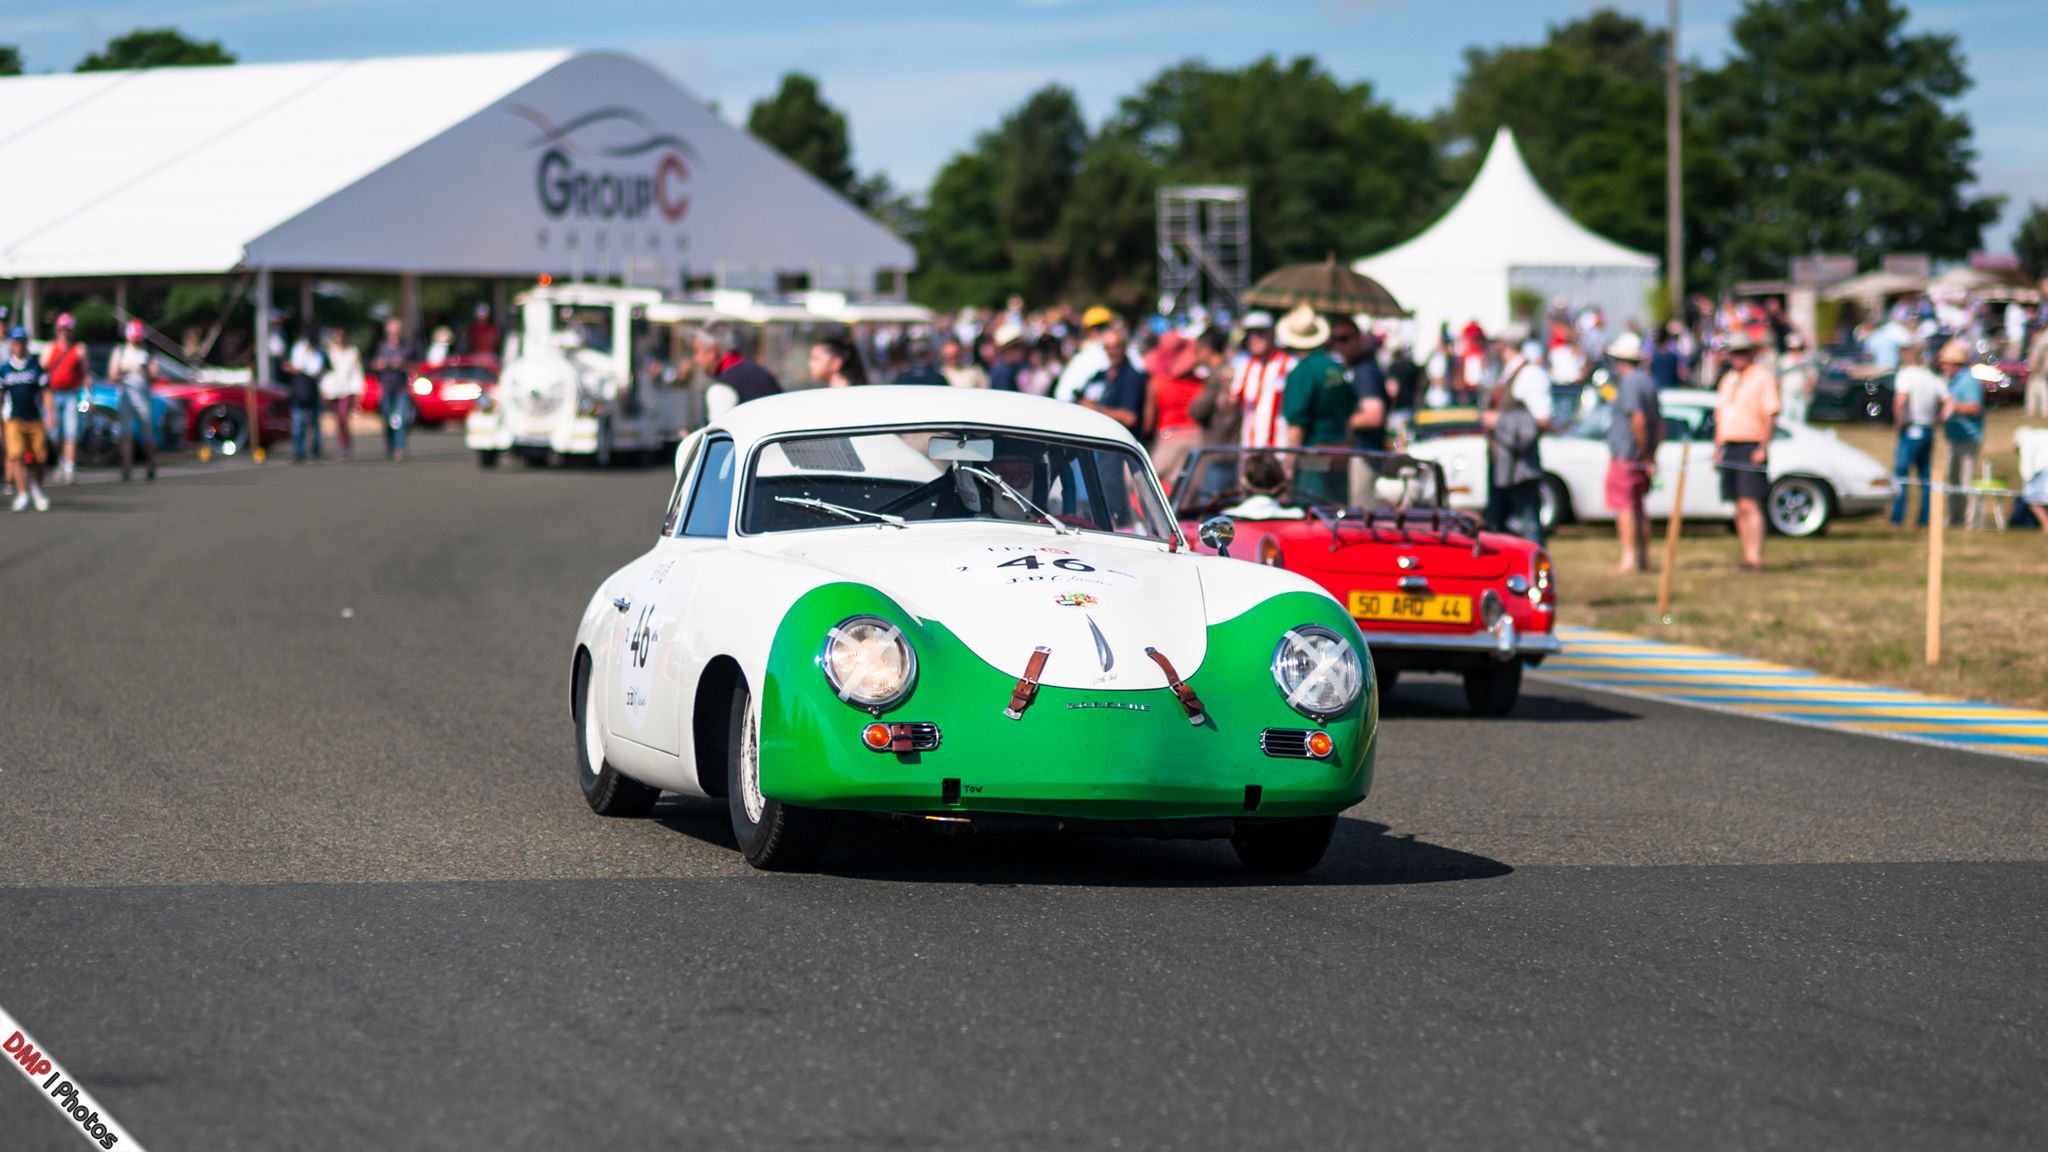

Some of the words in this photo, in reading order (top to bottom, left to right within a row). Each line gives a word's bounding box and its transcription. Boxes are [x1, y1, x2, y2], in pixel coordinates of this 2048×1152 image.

[997, 555, 1096, 572] 46
[1359, 596, 1380, 615] 50
[1440, 601, 1461, 618] 44
[630, 603, 656, 668] 46
[964, 785, 983, 793] TOW
